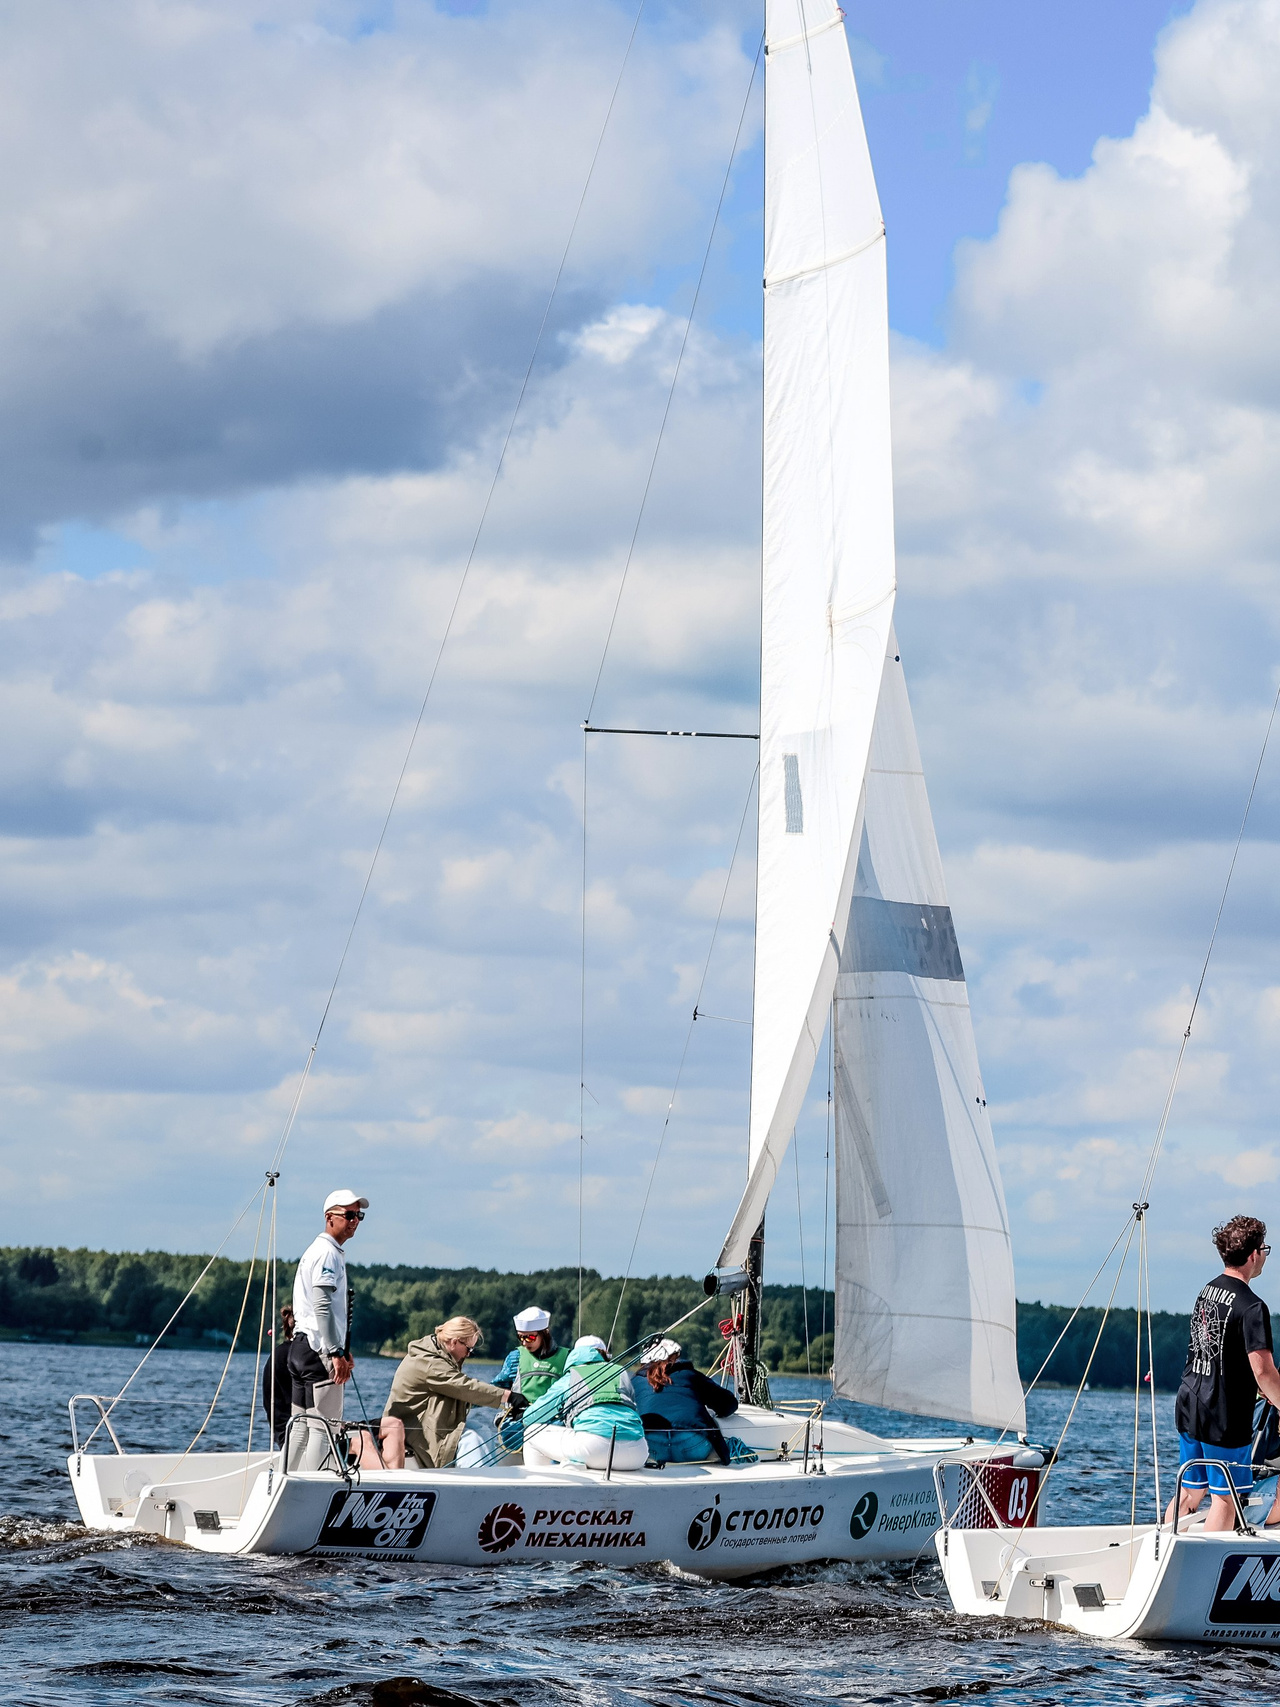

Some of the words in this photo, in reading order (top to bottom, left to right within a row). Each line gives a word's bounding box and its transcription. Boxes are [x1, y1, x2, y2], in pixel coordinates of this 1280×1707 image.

[889, 1489, 938, 1508] КОНАКОВО
[1007, 1476, 1028, 1521] 03
[532, 1510, 635, 1526] РУССКАЯ
[725, 1504, 825, 1532] СТОЛОТО
[877, 1510, 938, 1534] РиверКлаб
[525, 1532, 647, 1548] МЕХАНИКА
[720, 1535, 787, 1550] Государственные
[1202, 1629, 1267, 1639] смазочные
